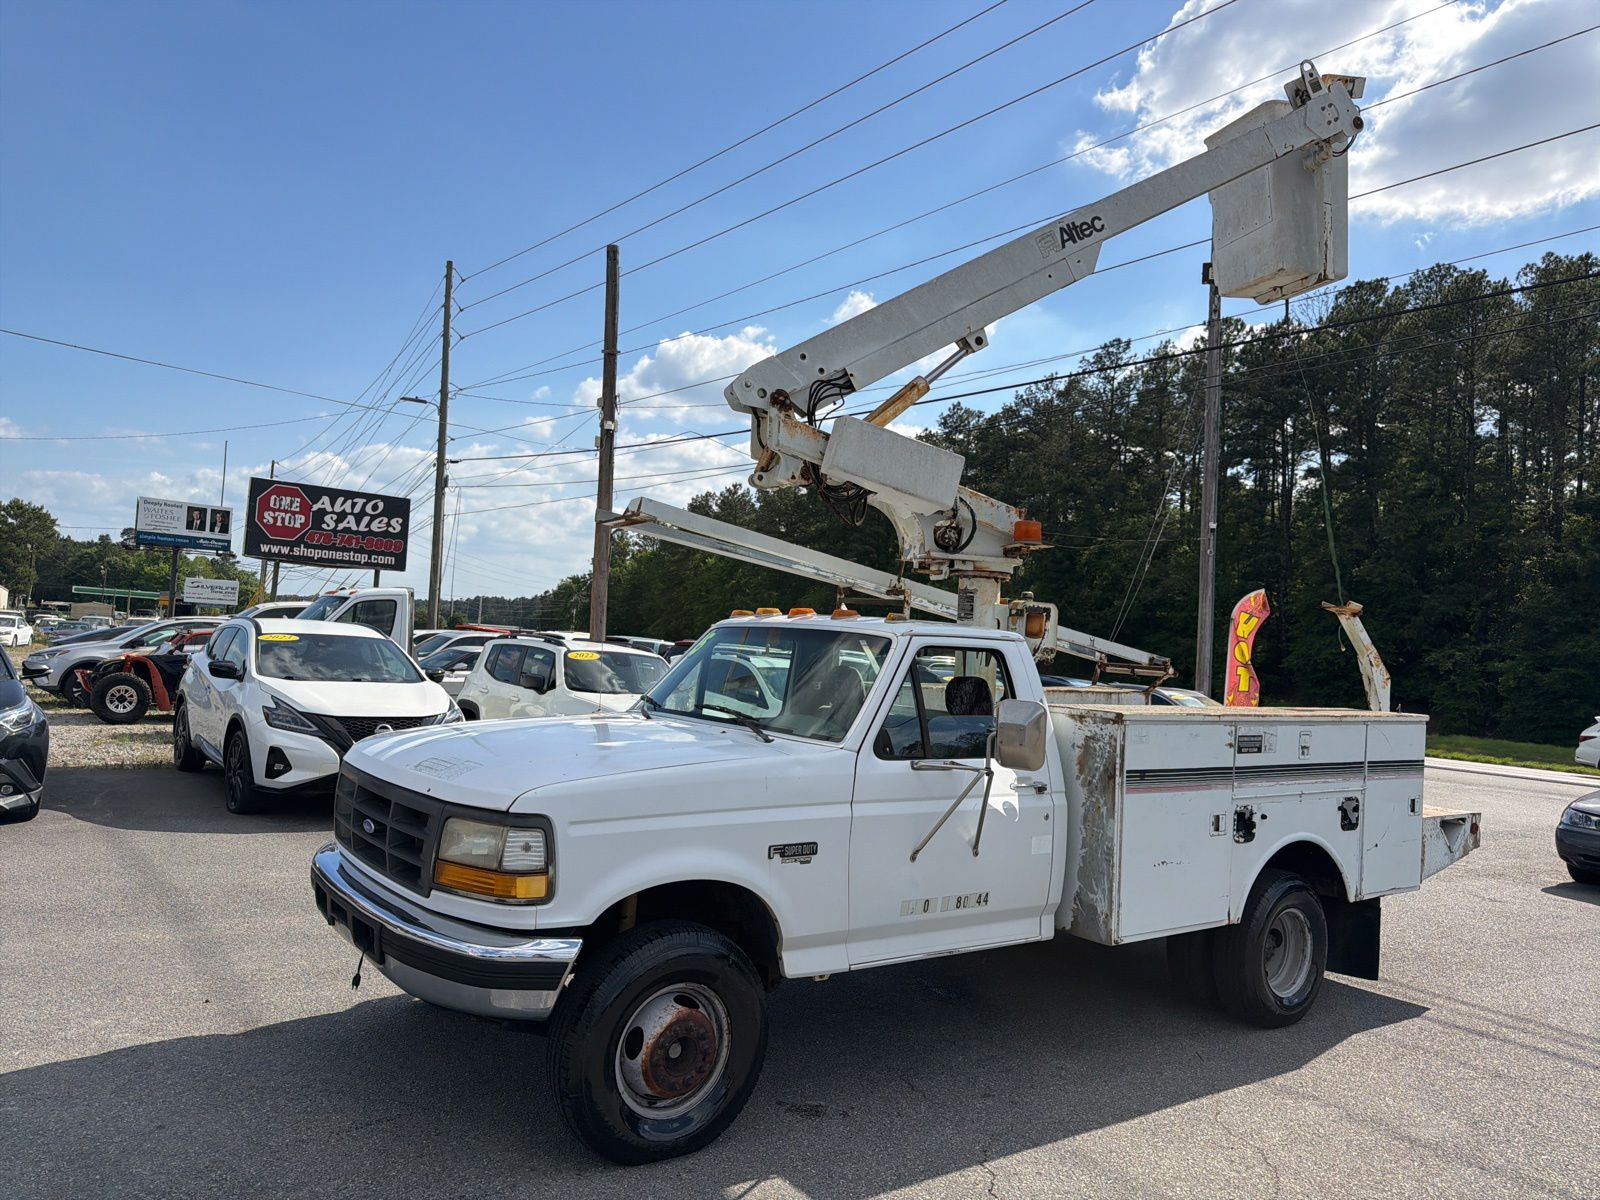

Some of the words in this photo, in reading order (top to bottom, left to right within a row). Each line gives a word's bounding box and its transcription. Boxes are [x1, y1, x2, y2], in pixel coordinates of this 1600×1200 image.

[1059, 216, 1105, 249] Altec
[143, 499, 163, 508] Deeply
[270, 494, 301, 511] ONE
[311, 495, 384, 515] AUTO
[263, 510, 305, 528] STOP
[260, 543, 395, 565] www.shoponestop.com
[784, 845, 801, 856] SUPER
[802, 844, 817, 854] DUTY
